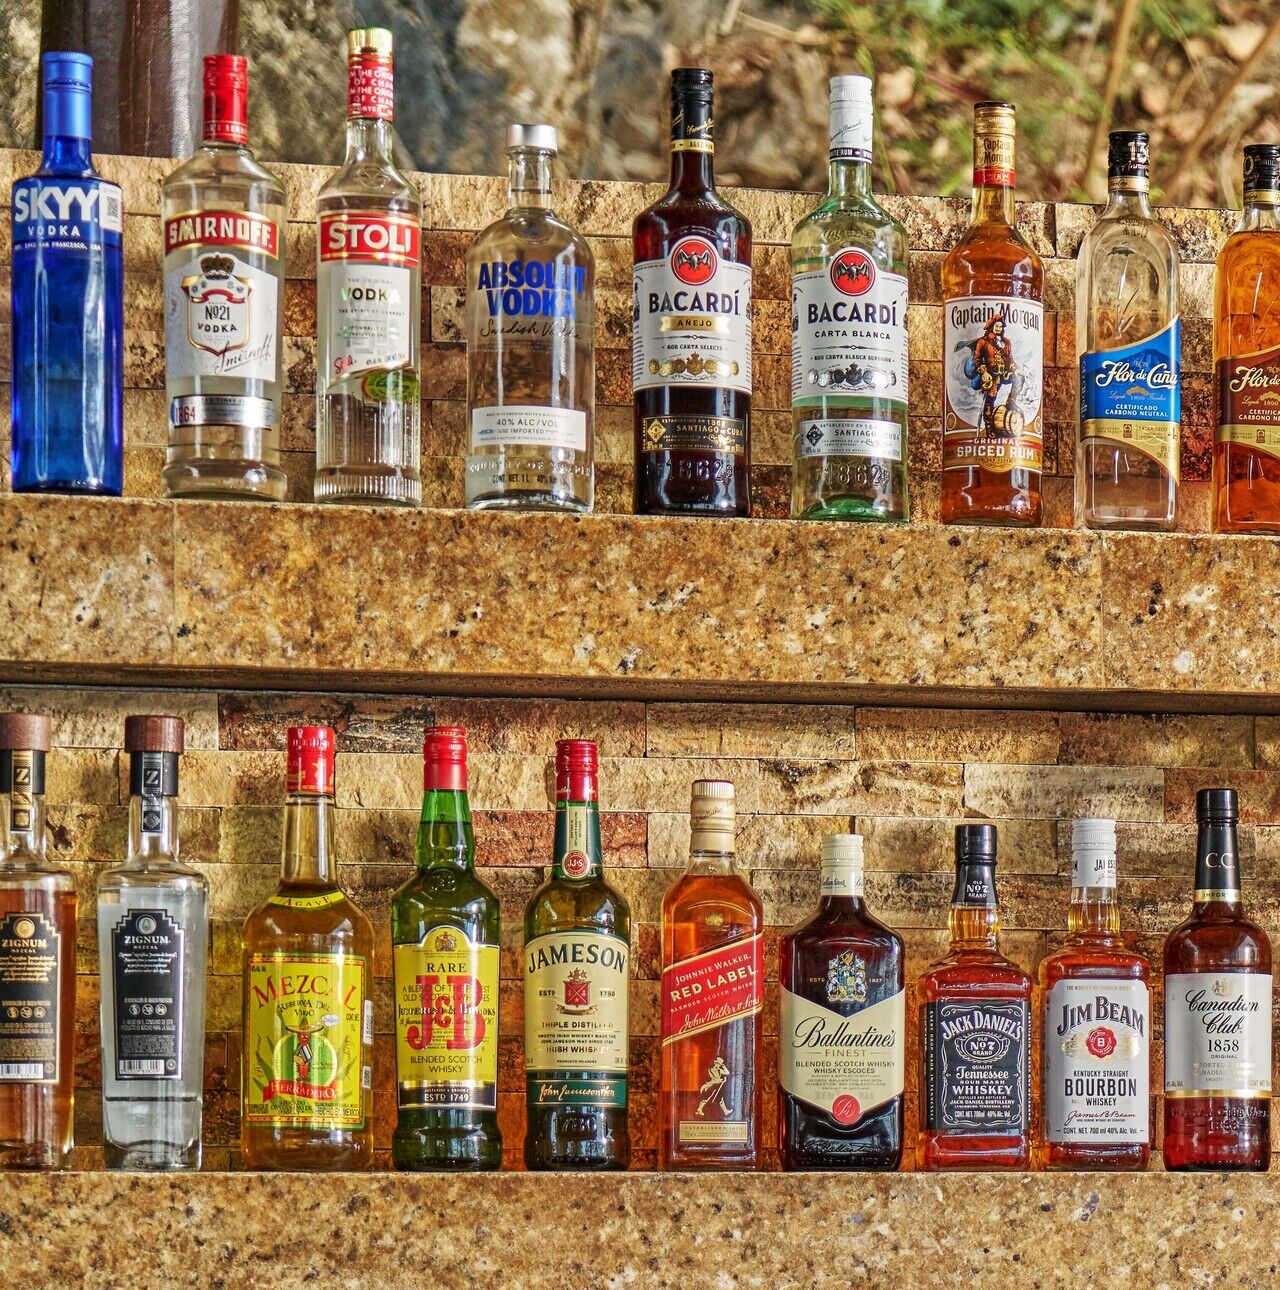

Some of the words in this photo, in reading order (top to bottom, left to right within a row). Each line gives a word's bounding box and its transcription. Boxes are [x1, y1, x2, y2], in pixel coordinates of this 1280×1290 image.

[28, 225, 81, 237] VODKA
[169, 217, 271, 247] SMIRNOFF
[329, 223, 412, 252] STOLI
[478, 261, 588, 290] ABSOLUT
[487, 289, 576, 318] VODKA
[649, 290, 739, 314] BACARDÍ
[808, 301, 896, 327] BACARDÍ
[678, 318, 712, 328] AÑEJO
[952, 302, 994, 329] Captain
[198, 323, 237, 333] VODKA
[852, 332, 890, 340] BLANCA
[1096, 361, 1135, 388] Flor
[1147, 364, 1177, 389] Caña
[1230, 367, 1270, 392] Flor
[957, 445, 1004, 457] SPICED
[1010, 447, 1034, 460] RUM
[282, 896, 331, 907] AGAVE
[124, 936, 169, 944] ZIGNUM
[427, 962, 466, 973] RARE
[529, 943, 625, 974] JAMESON
[676, 966, 713, 985] JOHNNIE
[714, 954, 750, 970] WALKER
[253, 975, 357, 1010] MEZCL
[670, 984, 702, 1001] RED
[707, 967, 757, 989] LABEL
[671, 1000, 701, 1013] BLENDED
[704, 989, 729, 1002] SCOTCH
[1185, 990, 1259, 1013] Canadian
[679, 1014, 706, 1032] John
[942, 1016, 973, 1039] JACK
[974, 1011, 1022, 1041] DANIEL'S
[1057, 1003, 1092, 1036] JIM
[1095, 996, 1144, 1037] BEAM
[1202, 1012, 1242, 1034] Club
[792, 1016, 896, 1048] Ballantine's
[1208, 1039, 1240, 1052] 1858
[956, 1066, 1009, 1079] Tennessee
[953, 1085, 1012, 1095] WHISKEY
[1065, 1078, 1137, 1097] BOURBON
[1086, 1098, 1116, 1106] WHISKEY
